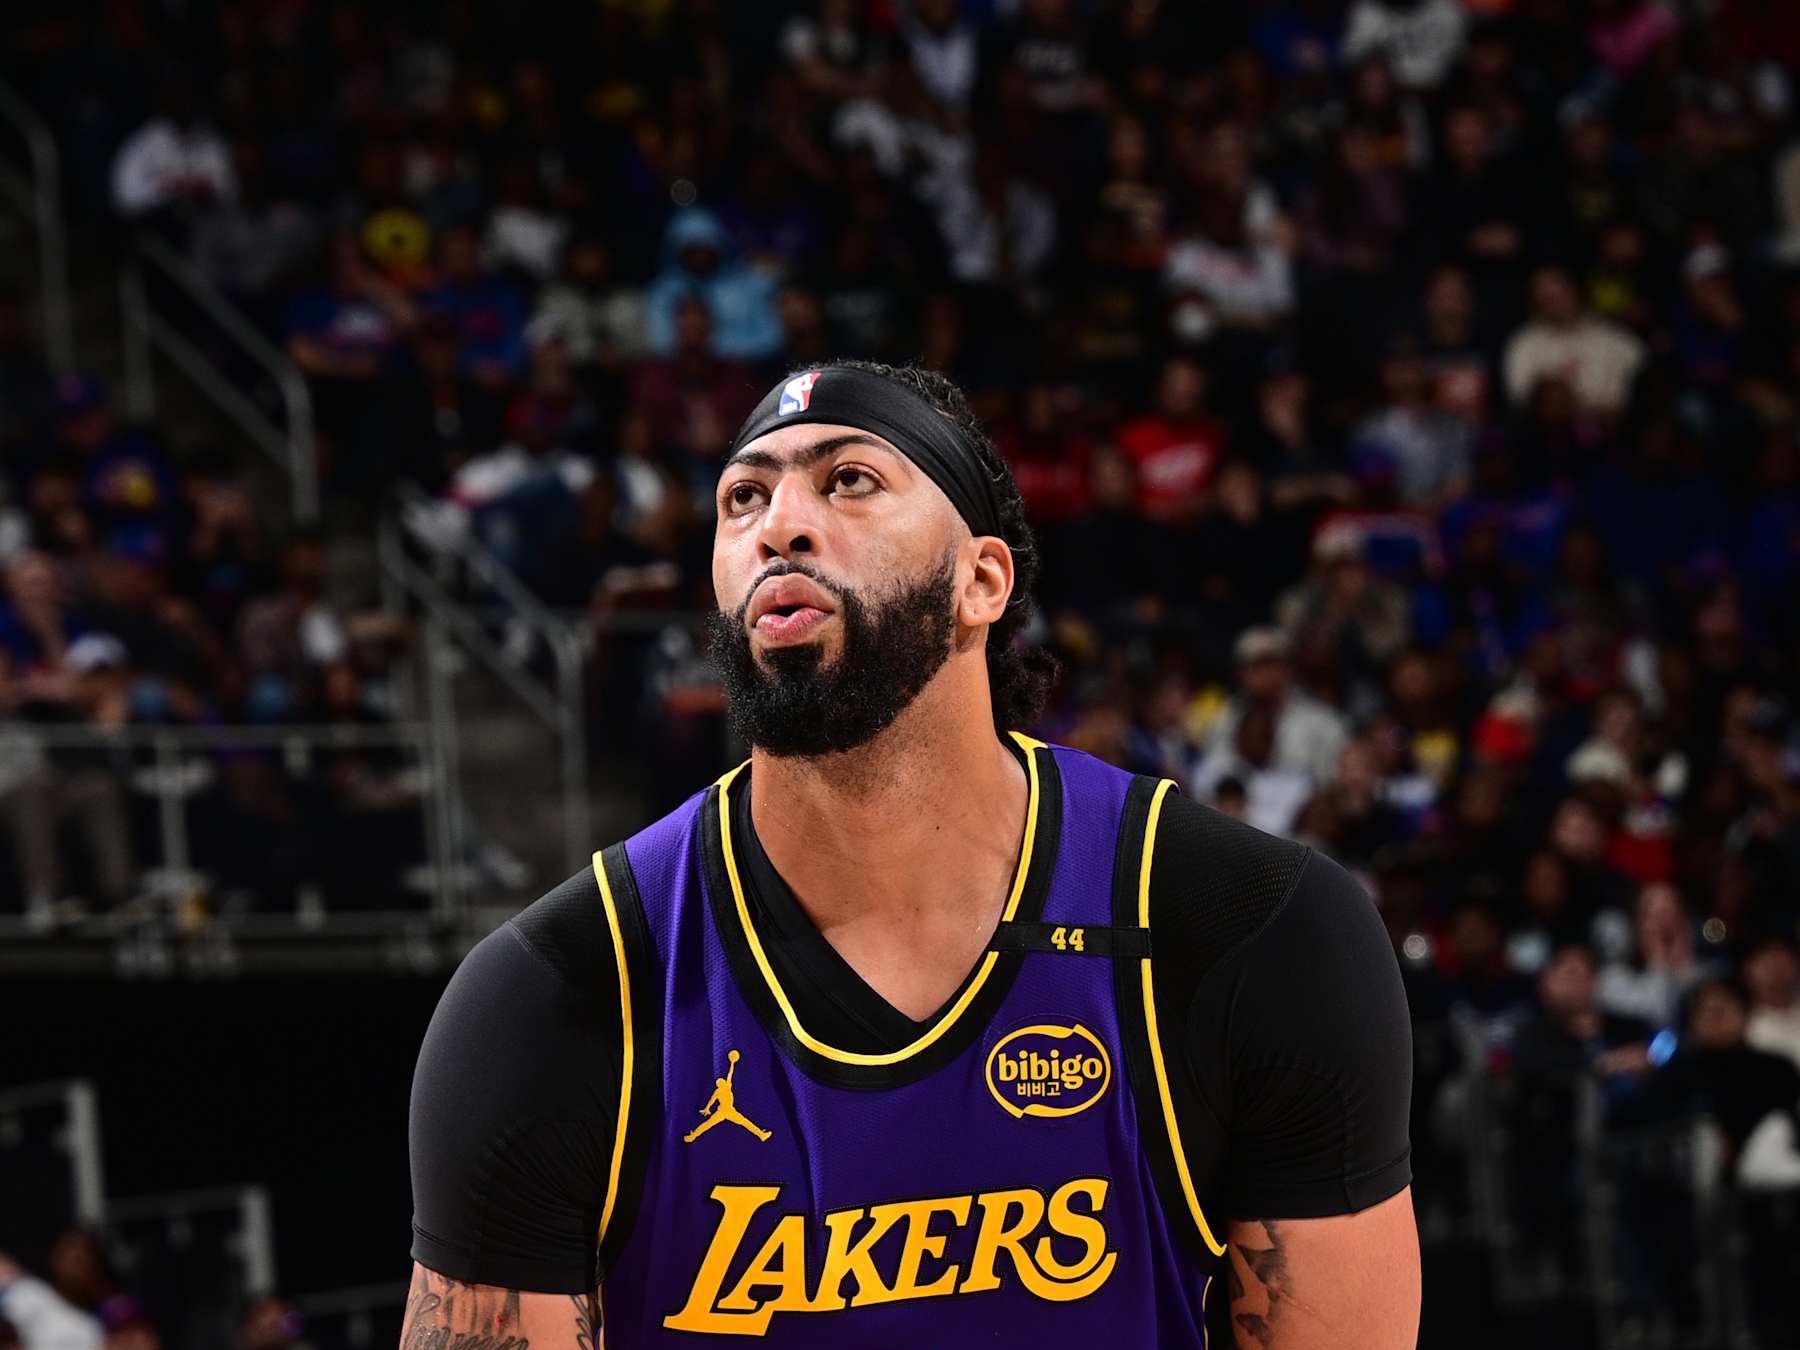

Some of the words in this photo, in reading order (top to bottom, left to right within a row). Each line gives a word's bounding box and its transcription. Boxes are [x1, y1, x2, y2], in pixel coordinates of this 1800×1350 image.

[1051, 927, 1084, 951] 44
[998, 1049, 1103, 1090] bibigo
[1017, 1081, 1061, 1097] 비비고
